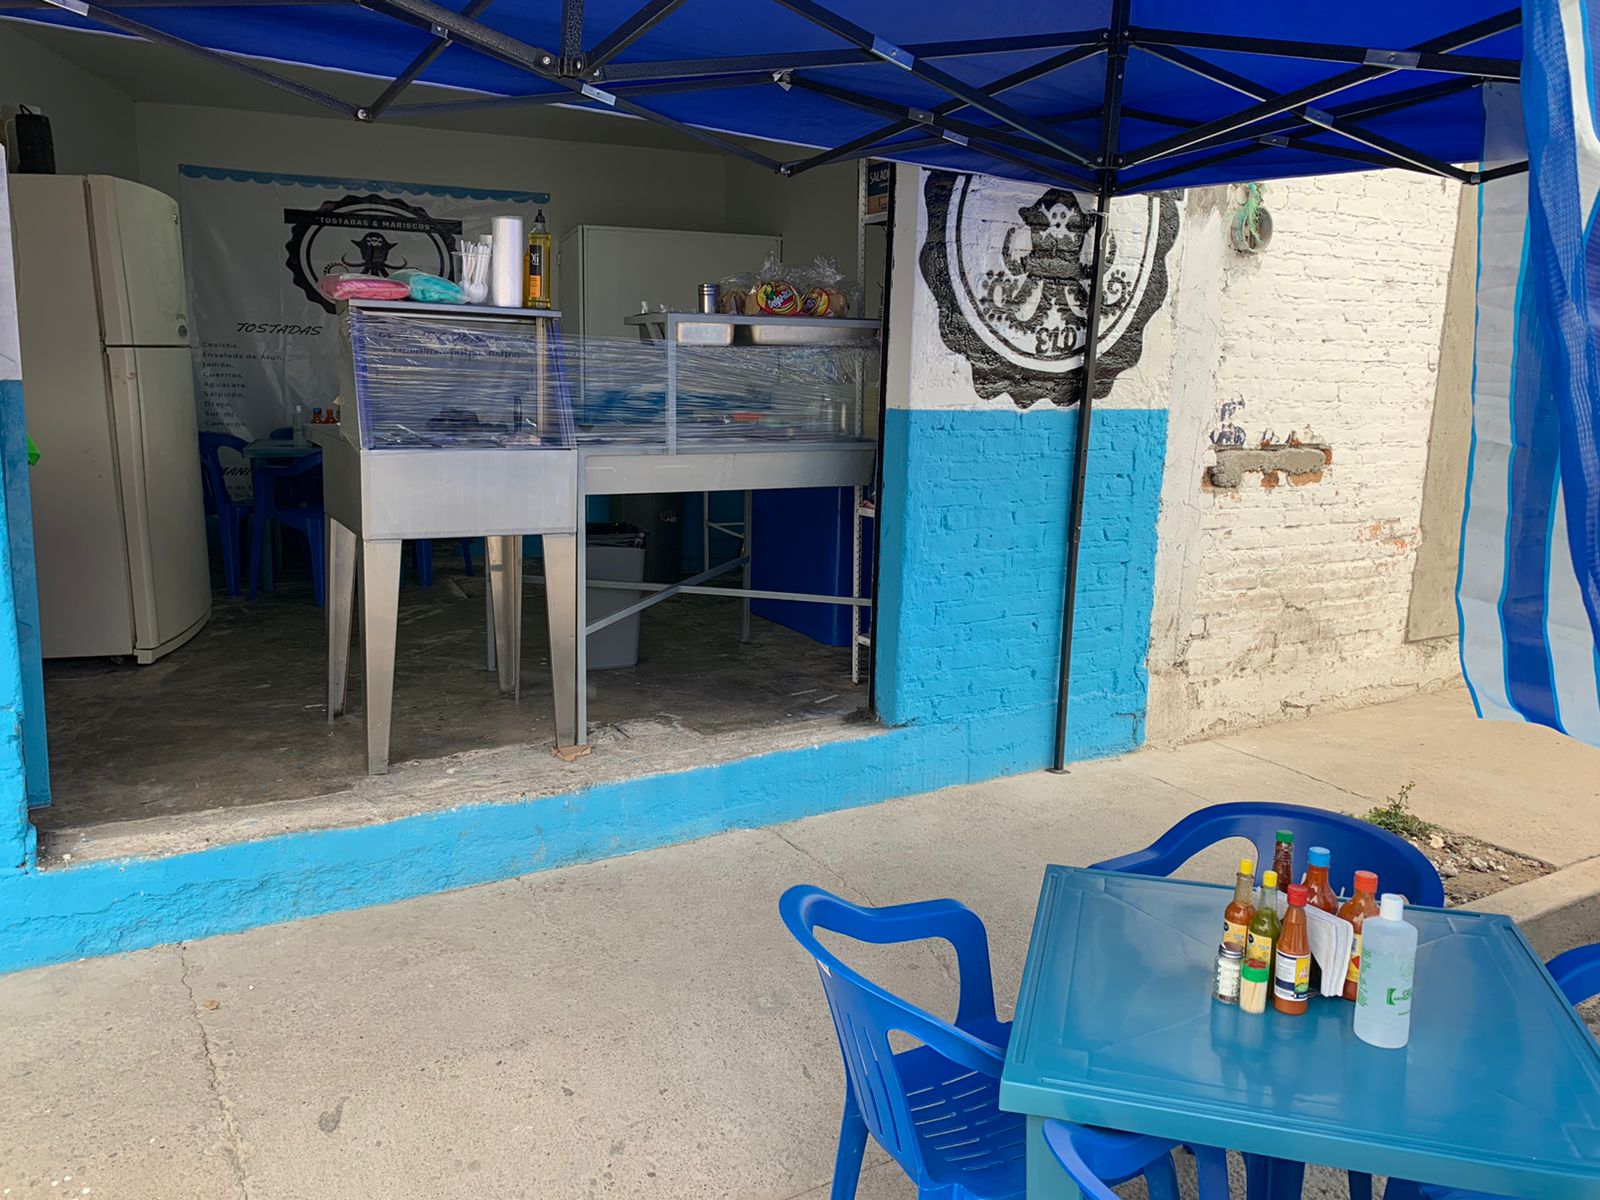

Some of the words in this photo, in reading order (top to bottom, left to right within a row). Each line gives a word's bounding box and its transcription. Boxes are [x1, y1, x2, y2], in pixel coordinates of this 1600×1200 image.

[371, 219, 379, 227] &
[236, 321, 324, 336] TOSTADAS
[202, 351, 244, 360] Ensalada
[245, 352, 257, 360] de
